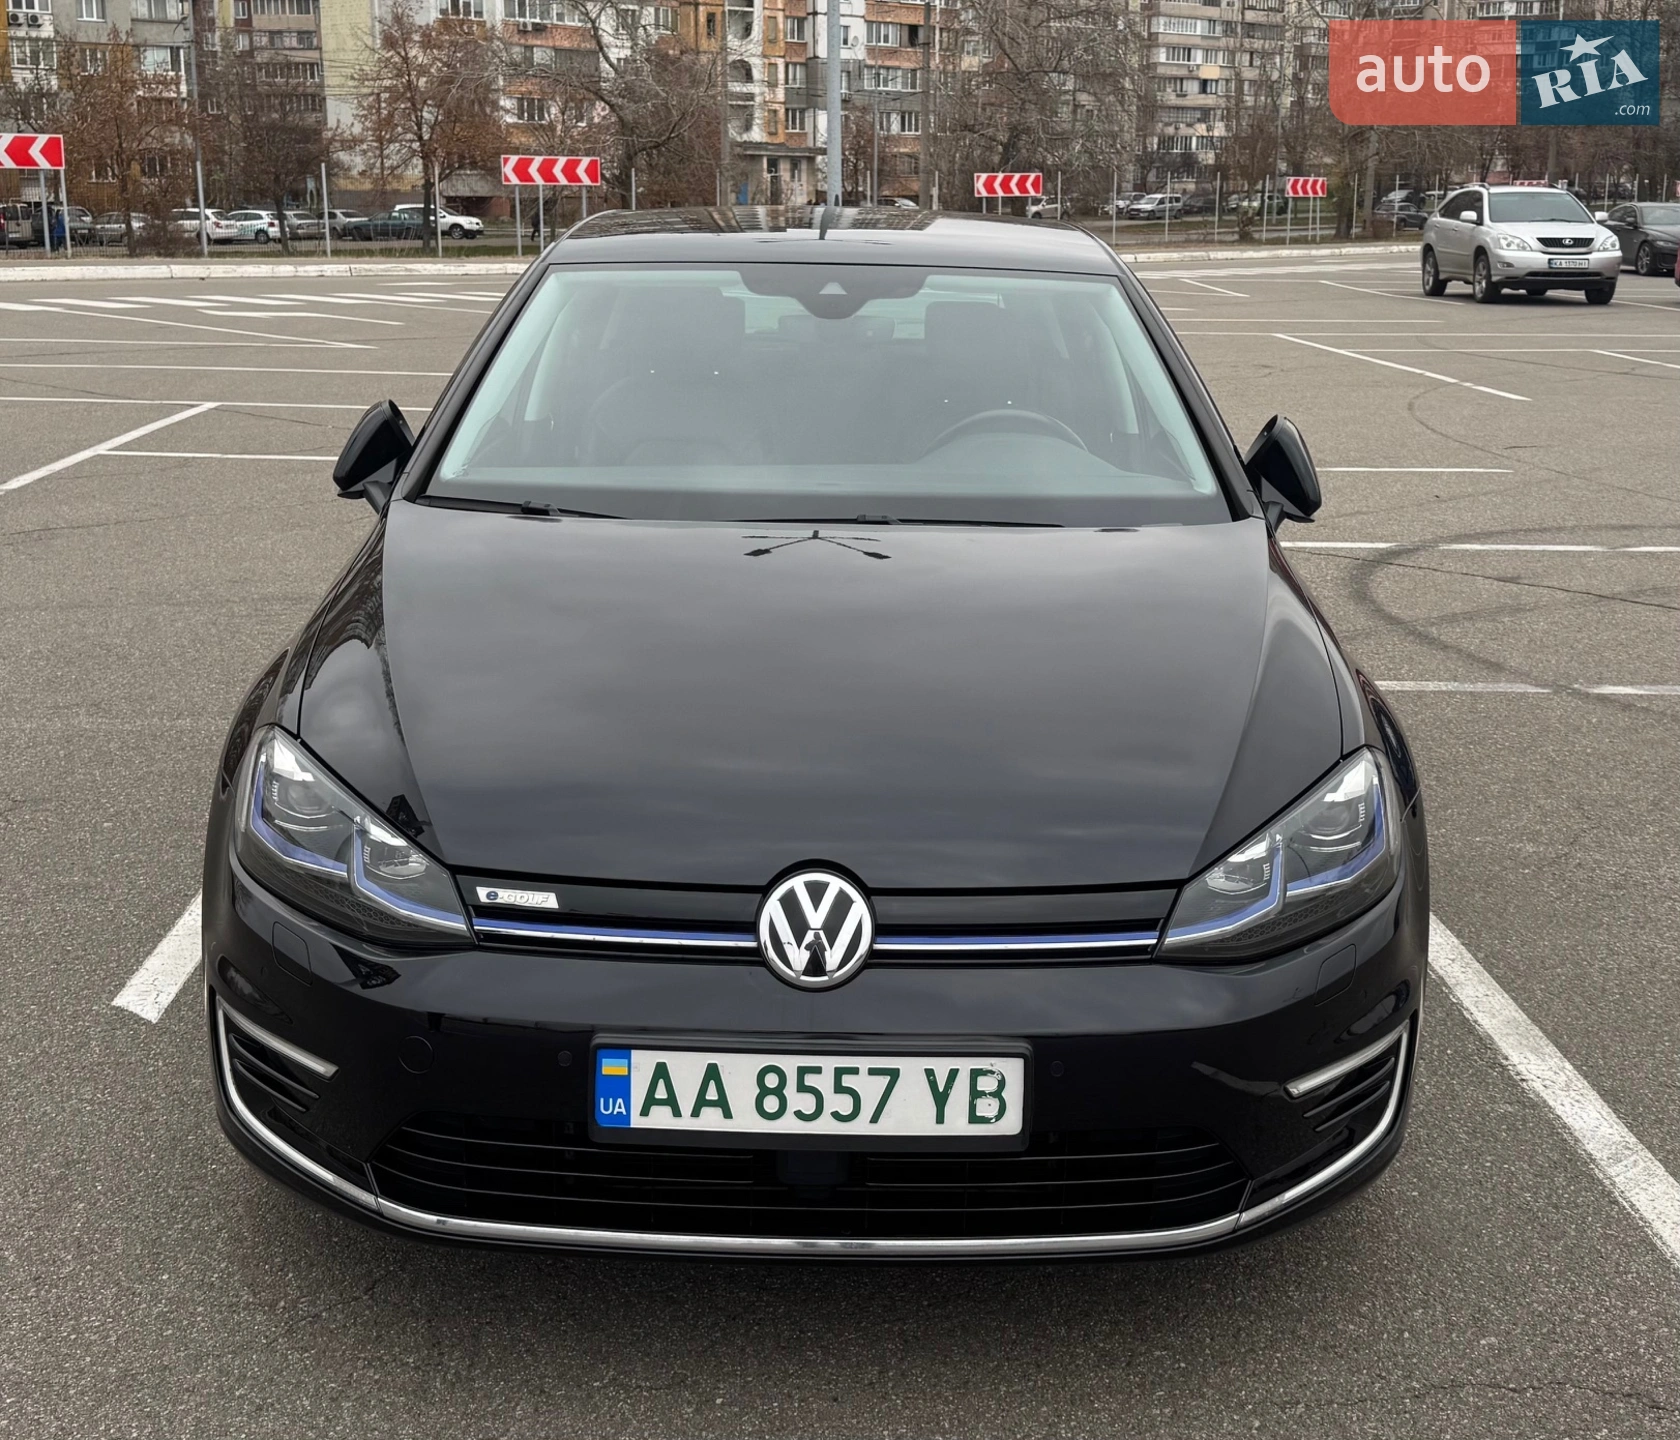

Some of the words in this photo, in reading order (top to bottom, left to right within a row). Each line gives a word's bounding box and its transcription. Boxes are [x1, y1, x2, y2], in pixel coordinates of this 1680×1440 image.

[600, 1098, 627, 1116] UA
[639, 1061, 734, 1120] AA
[755, 1064, 901, 1125] 8557
[923, 1067, 1007, 1125] YB
